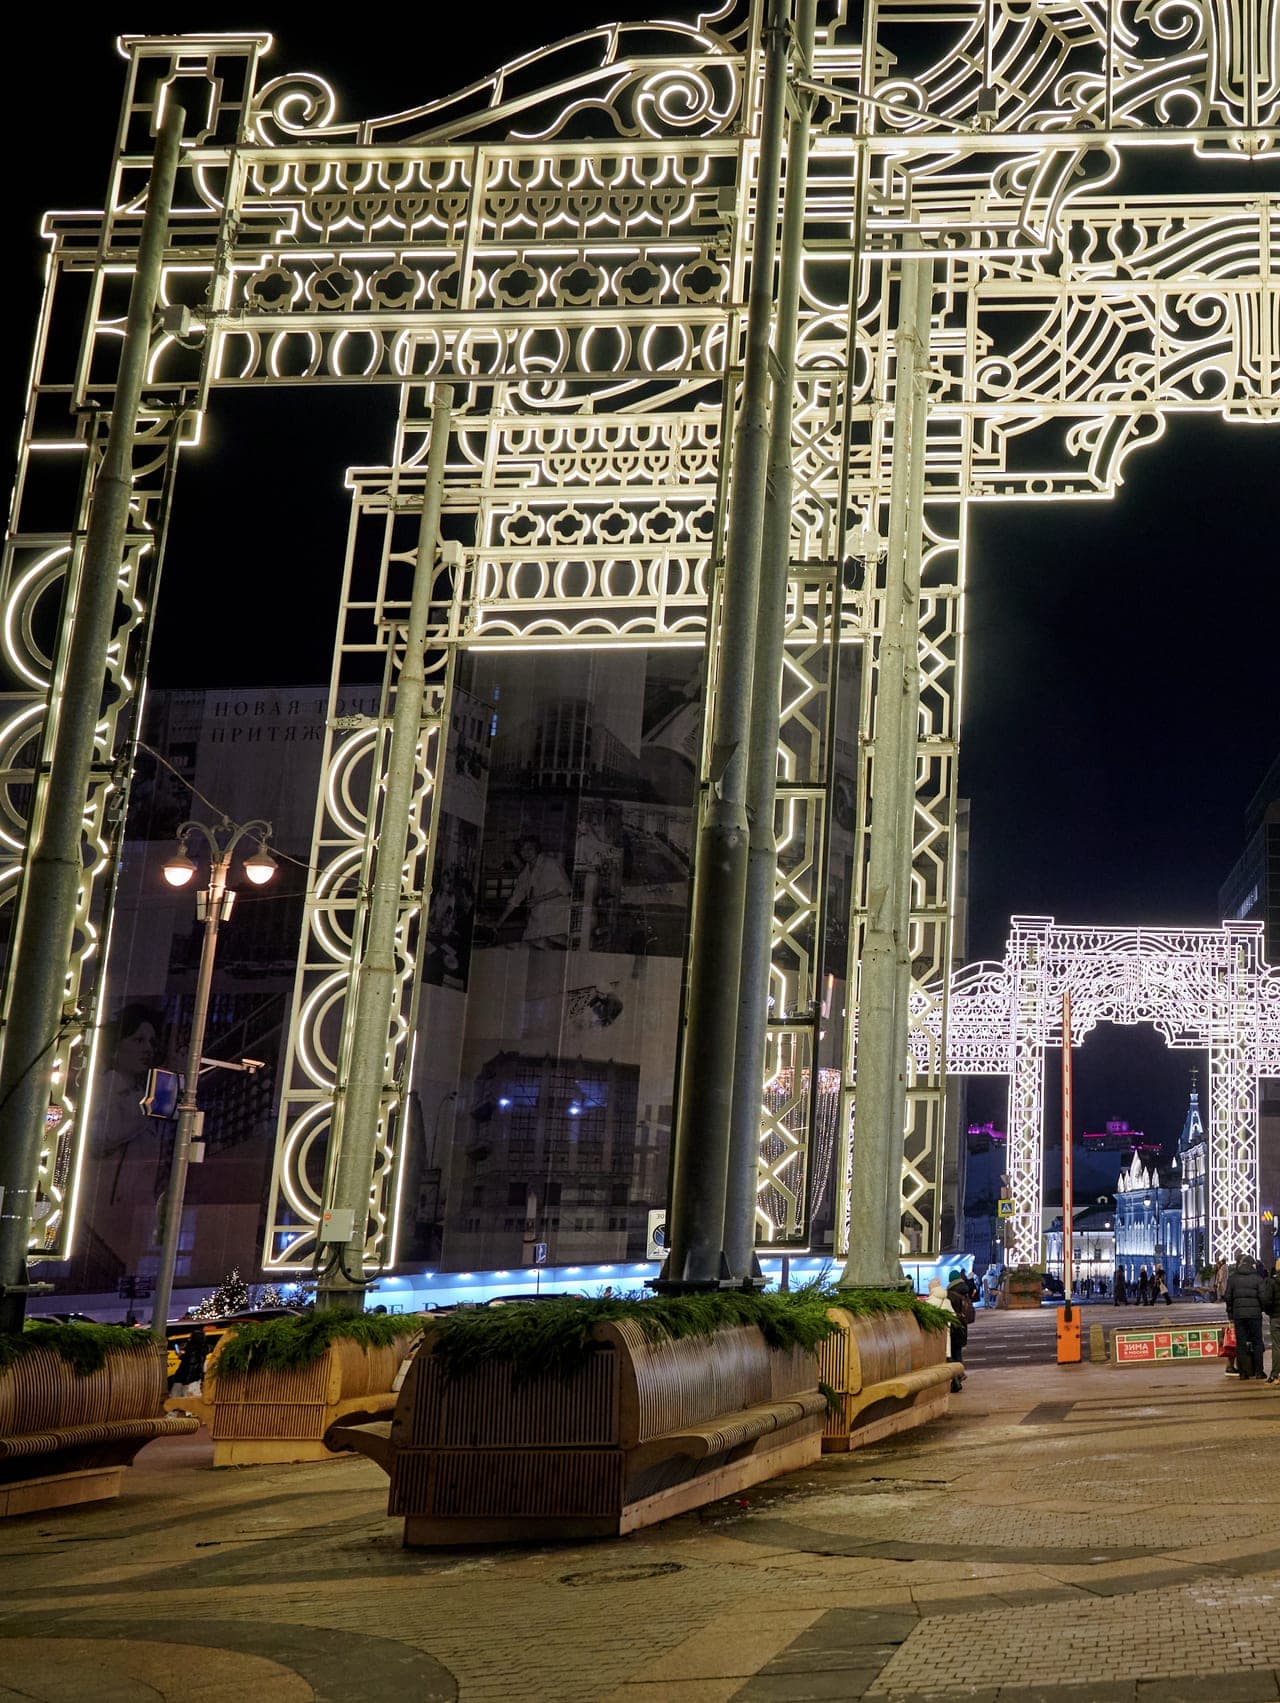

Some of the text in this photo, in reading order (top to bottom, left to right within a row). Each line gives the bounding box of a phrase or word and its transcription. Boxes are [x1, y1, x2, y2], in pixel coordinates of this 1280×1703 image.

[215, 699, 300, 717] НОВАЯ
[211, 724, 322, 743] ПРИТЯЖ
[1123, 1343, 1149, 1352] ЗИМА
